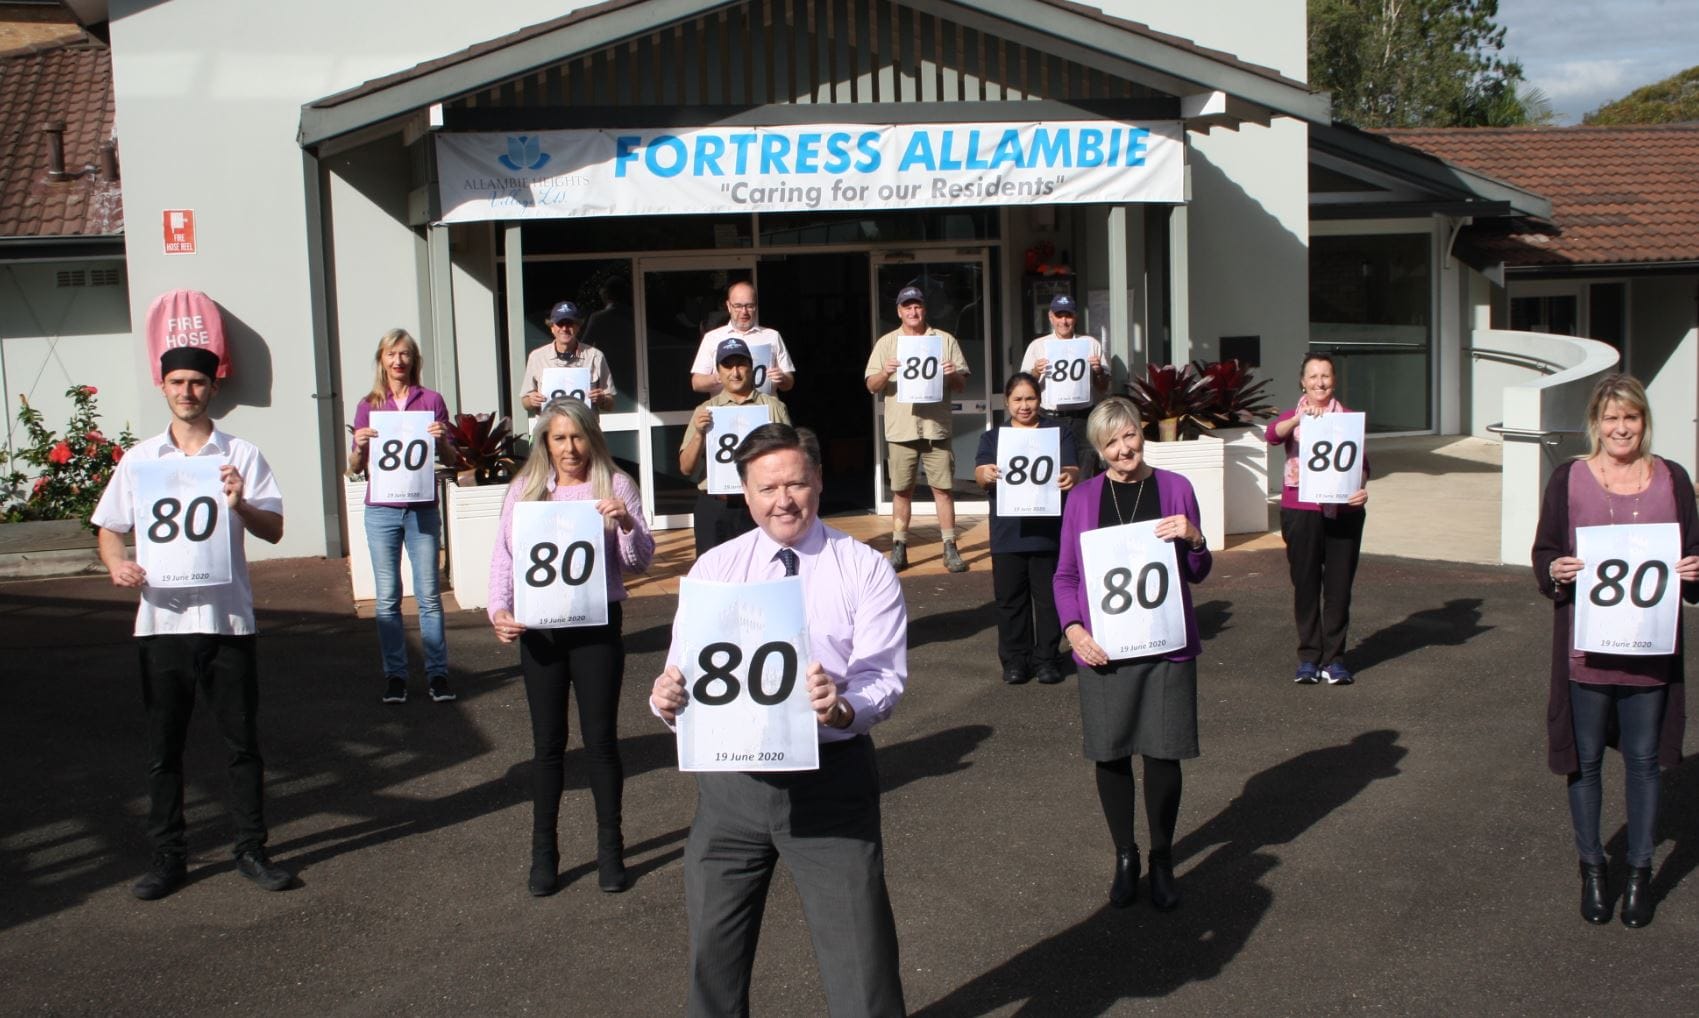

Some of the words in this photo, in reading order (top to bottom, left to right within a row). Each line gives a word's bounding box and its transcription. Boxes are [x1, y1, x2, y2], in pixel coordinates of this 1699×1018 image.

[615, 131, 883, 178] FORTRESS
[898, 127, 1151, 172] ALLAMBIE
[463, 176, 528, 190] ALLAMBIE
[532, 175, 590, 188] HEIGHTS
[720, 181, 822, 208] "Caring
[831, 179, 869, 202] for
[878, 183, 922, 201] our
[931, 175, 1065, 199] Residents"
[167, 242, 180, 251] HOSE
[181, 242, 193, 251] REEL
[174, 233, 185, 242] FIRE
[167, 315, 204, 332] FIRE
[165, 331, 209, 348] HOSE
[902, 356, 938, 380] 80
[1052, 358, 1086, 382] 80
[378, 439, 429, 471] 80
[1307, 440, 1358, 473] 80
[1005, 455, 1054, 486] 80
[147, 496, 218, 544] 80
[525, 540, 595, 588] 80
[162, 574, 171, 582] 19
[191, 572, 210, 581] 2020
[1102, 561, 1169, 615] 80
[1589, 558, 1669, 609] 80
[539, 617, 549, 625] 19
[549, 616, 567, 624] June
[567, 615, 586, 623] 2020
[1120, 645, 1130, 653] 19
[1130, 643, 1147, 652] June
[1148, 639, 1167, 649] 2020
[1601, 640, 1611, 648] 19
[1611, 640, 1631, 649] June
[1631, 641, 1653, 649] 2020
[692, 641, 798, 706] 80
[715, 752, 729, 762] 19
[730, 751, 755, 762] June
[757, 751, 785, 762] 2020
